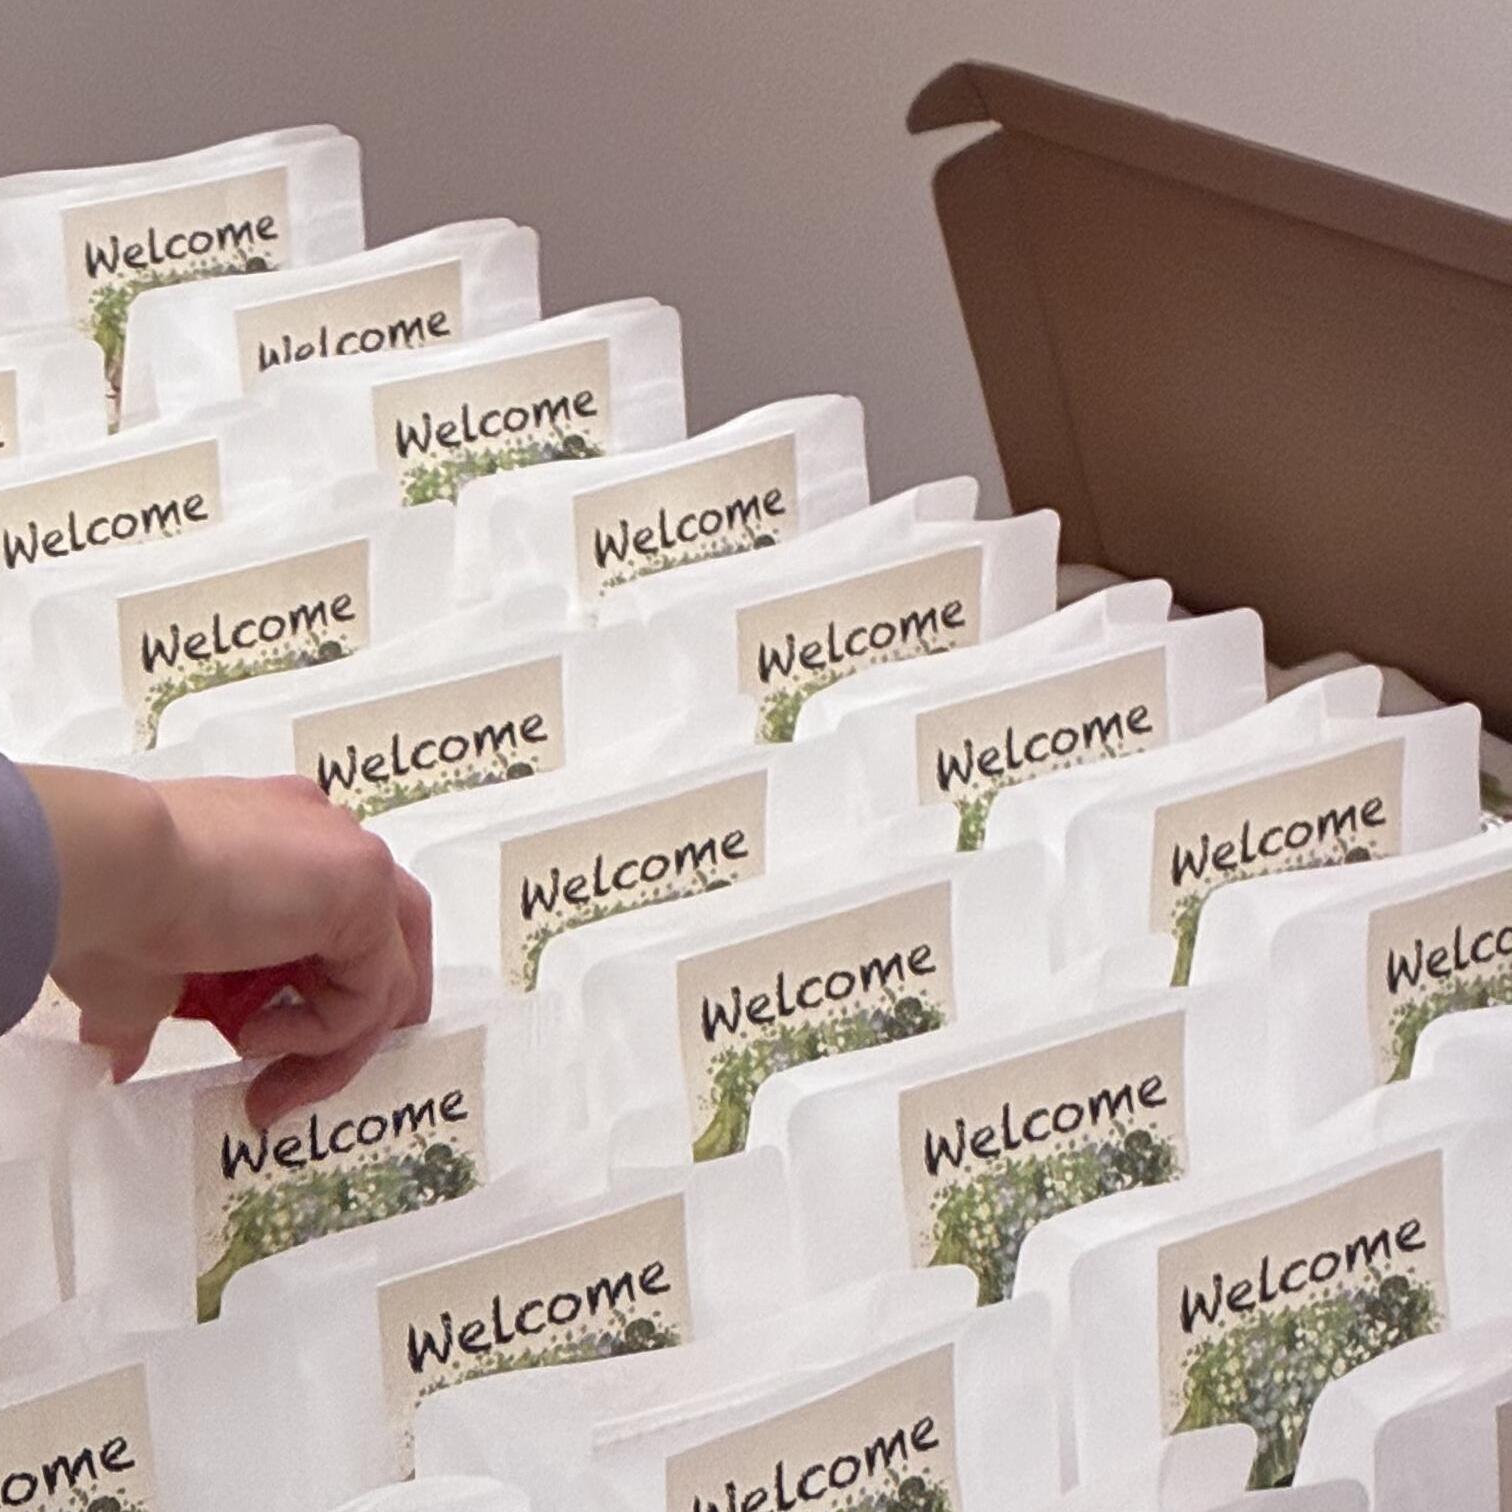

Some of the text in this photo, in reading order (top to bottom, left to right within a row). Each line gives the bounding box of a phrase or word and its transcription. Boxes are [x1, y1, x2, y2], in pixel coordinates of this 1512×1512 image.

[85, 215, 279, 278] Welcome
[395, 389, 598, 458] Welcome
[4, 495, 209, 569] Welcome
[594, 485, 786, 569] Welcome
[142, 594, 357, 673] Welcome
[758, 599, 966, 683] Welcome
[318, 712, 549, 795] Welcome
[937, 704, 1153, 791] Welcome
[521, 827, 749, 922] Welcome
[1171, 794, 1387, 886] Welcome
[702, 942, 937, 1042] Welcome
[1387, 924, 1512, 995] Welco
[220, 1087, 468, 1180] Welcome
[925, 1074, 1168, 1176] Welcome
[408, 1259, 671, 1374] Welcome
[1181, 1219, 1426, 1333] Welcome
